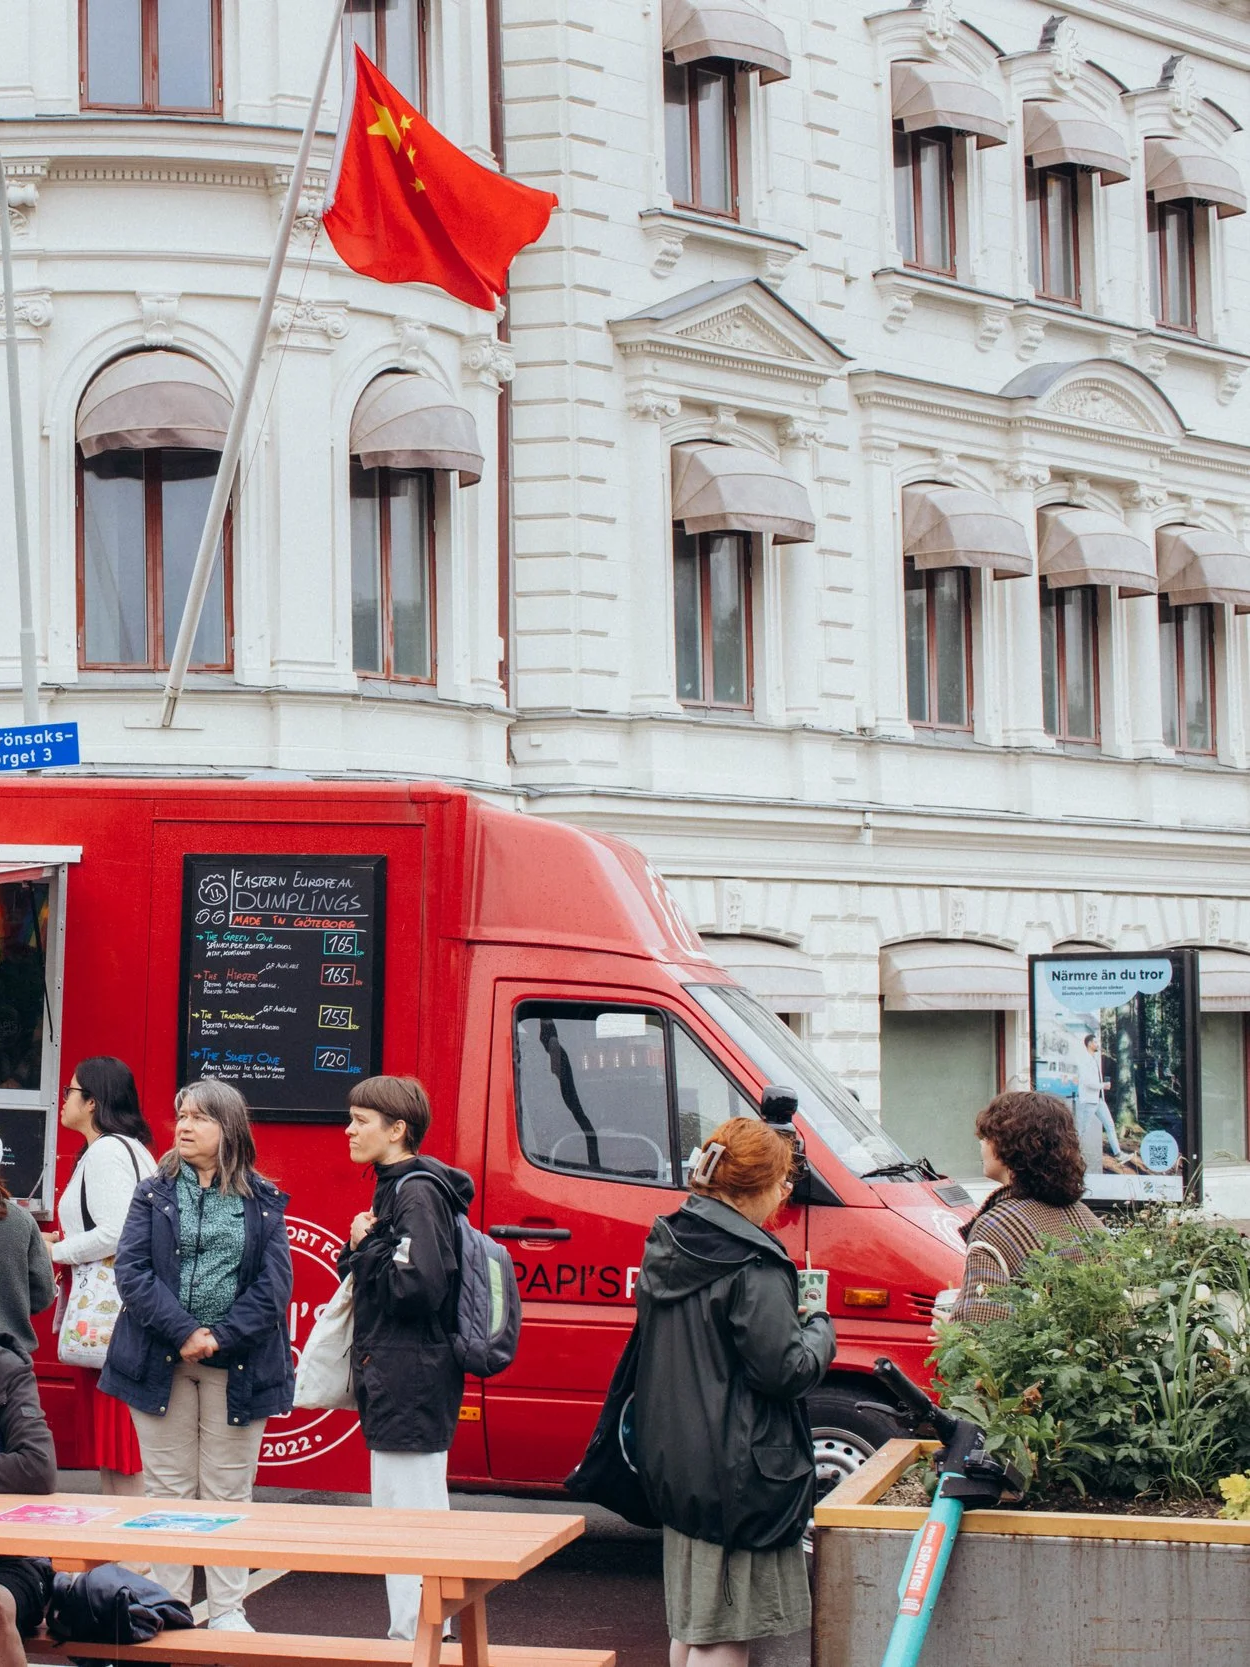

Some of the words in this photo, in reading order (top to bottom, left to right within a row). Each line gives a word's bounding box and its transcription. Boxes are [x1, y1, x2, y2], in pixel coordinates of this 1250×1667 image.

[43, 748, 52, 761] 3
[232, 915, 262, 926] MADE
[293, 917, 355, 929] GÖTEBORG
[328, 935, 354, 954] 165
[325, 967, 351, 985] 165
[1052, 970, 1098, 981] Närmre
[1101, 969, 1116, 980] än
[1120, 969, 1136, 980] du
[1139, 969, 1164, 980] tror
[323, 1008, 349, 1026] 155
[318, 1051, 346, 1067] 120
[262, 1436, 312, 1458] 2022
